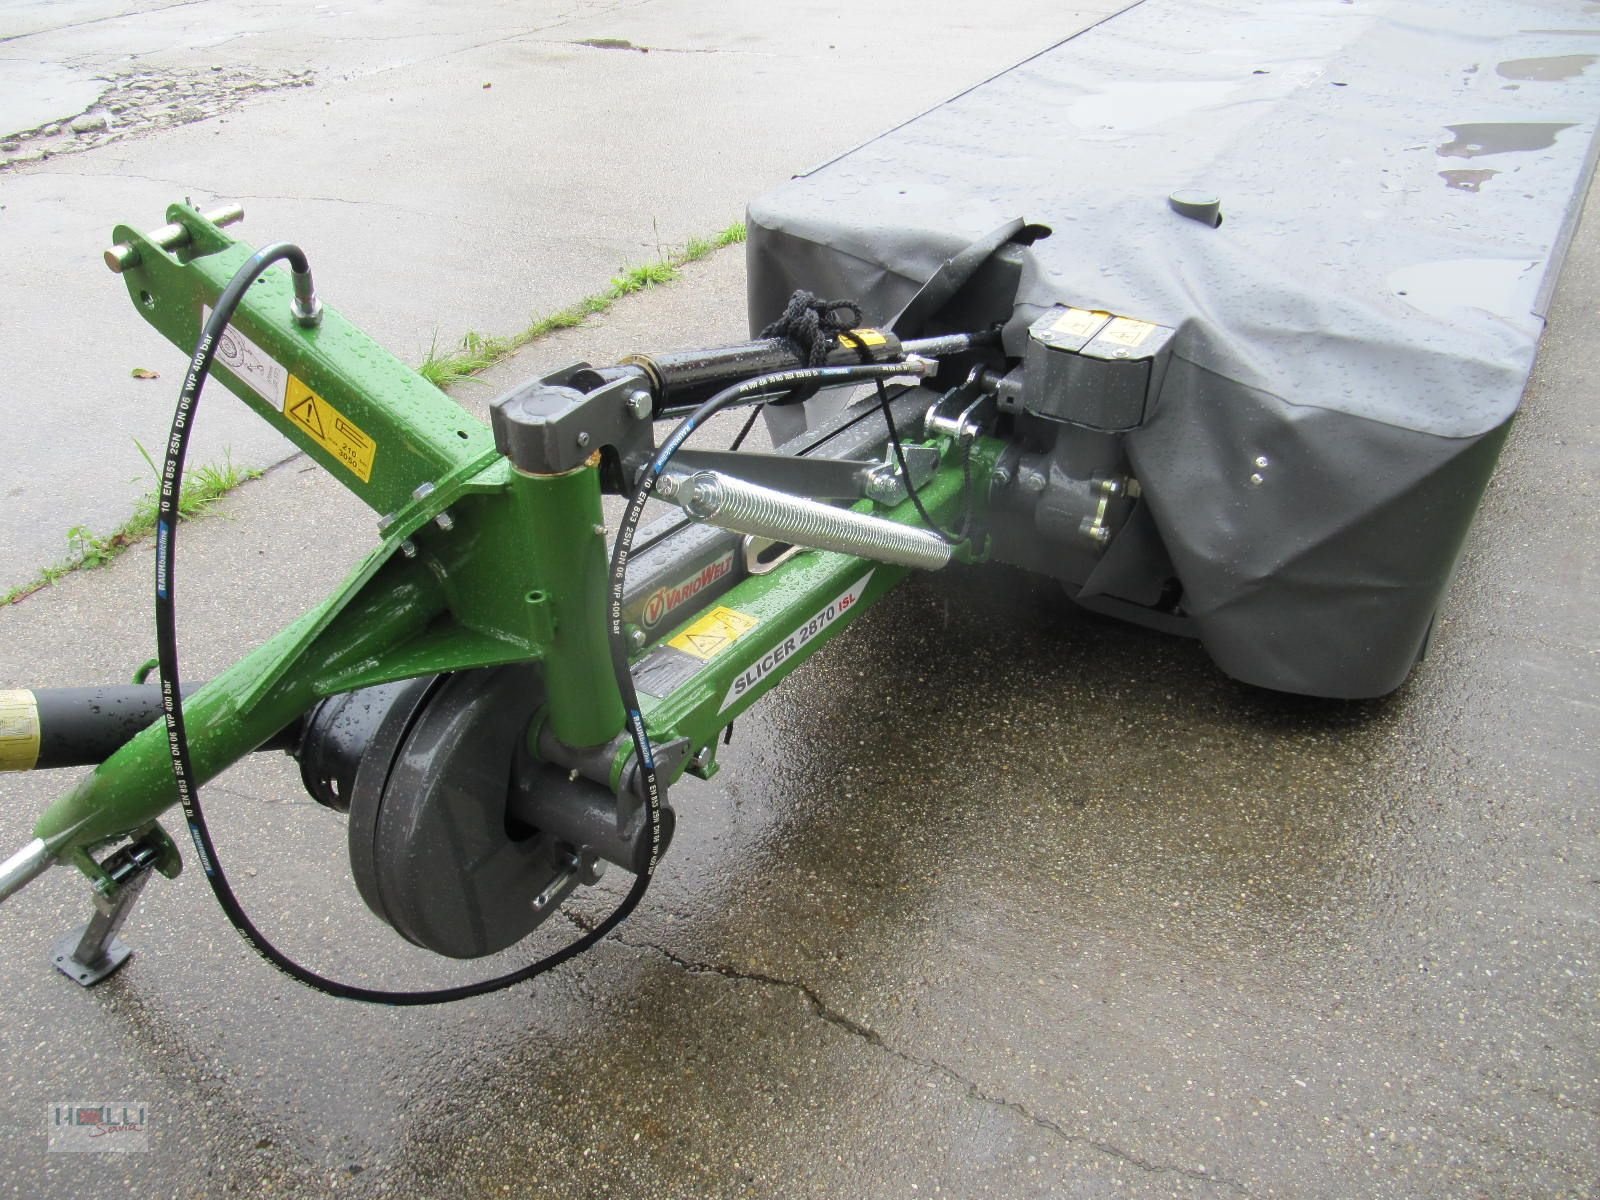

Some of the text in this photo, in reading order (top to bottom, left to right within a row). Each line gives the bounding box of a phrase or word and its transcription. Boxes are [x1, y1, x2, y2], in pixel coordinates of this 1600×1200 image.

[161, 333, 213, 513] 10 EN 853 2SN DN 06 WP 400 bar
[612, 478, 653, 635] 10 EN 853 2SN DN 06 WP 400 bar
[734, 637, 797, 695] SLICER
[799, 605, 835, 644] 2870
[838, 593, 856, 612] ISL
[163, 680, 172, 694] bar
[164, 696, 173, 712] 400
[166, 713, 176, 728] WP
[169, 731, 178, 742] 06
[171, 743, 180, 756] DN
[181, 794, 191, 806] EN
